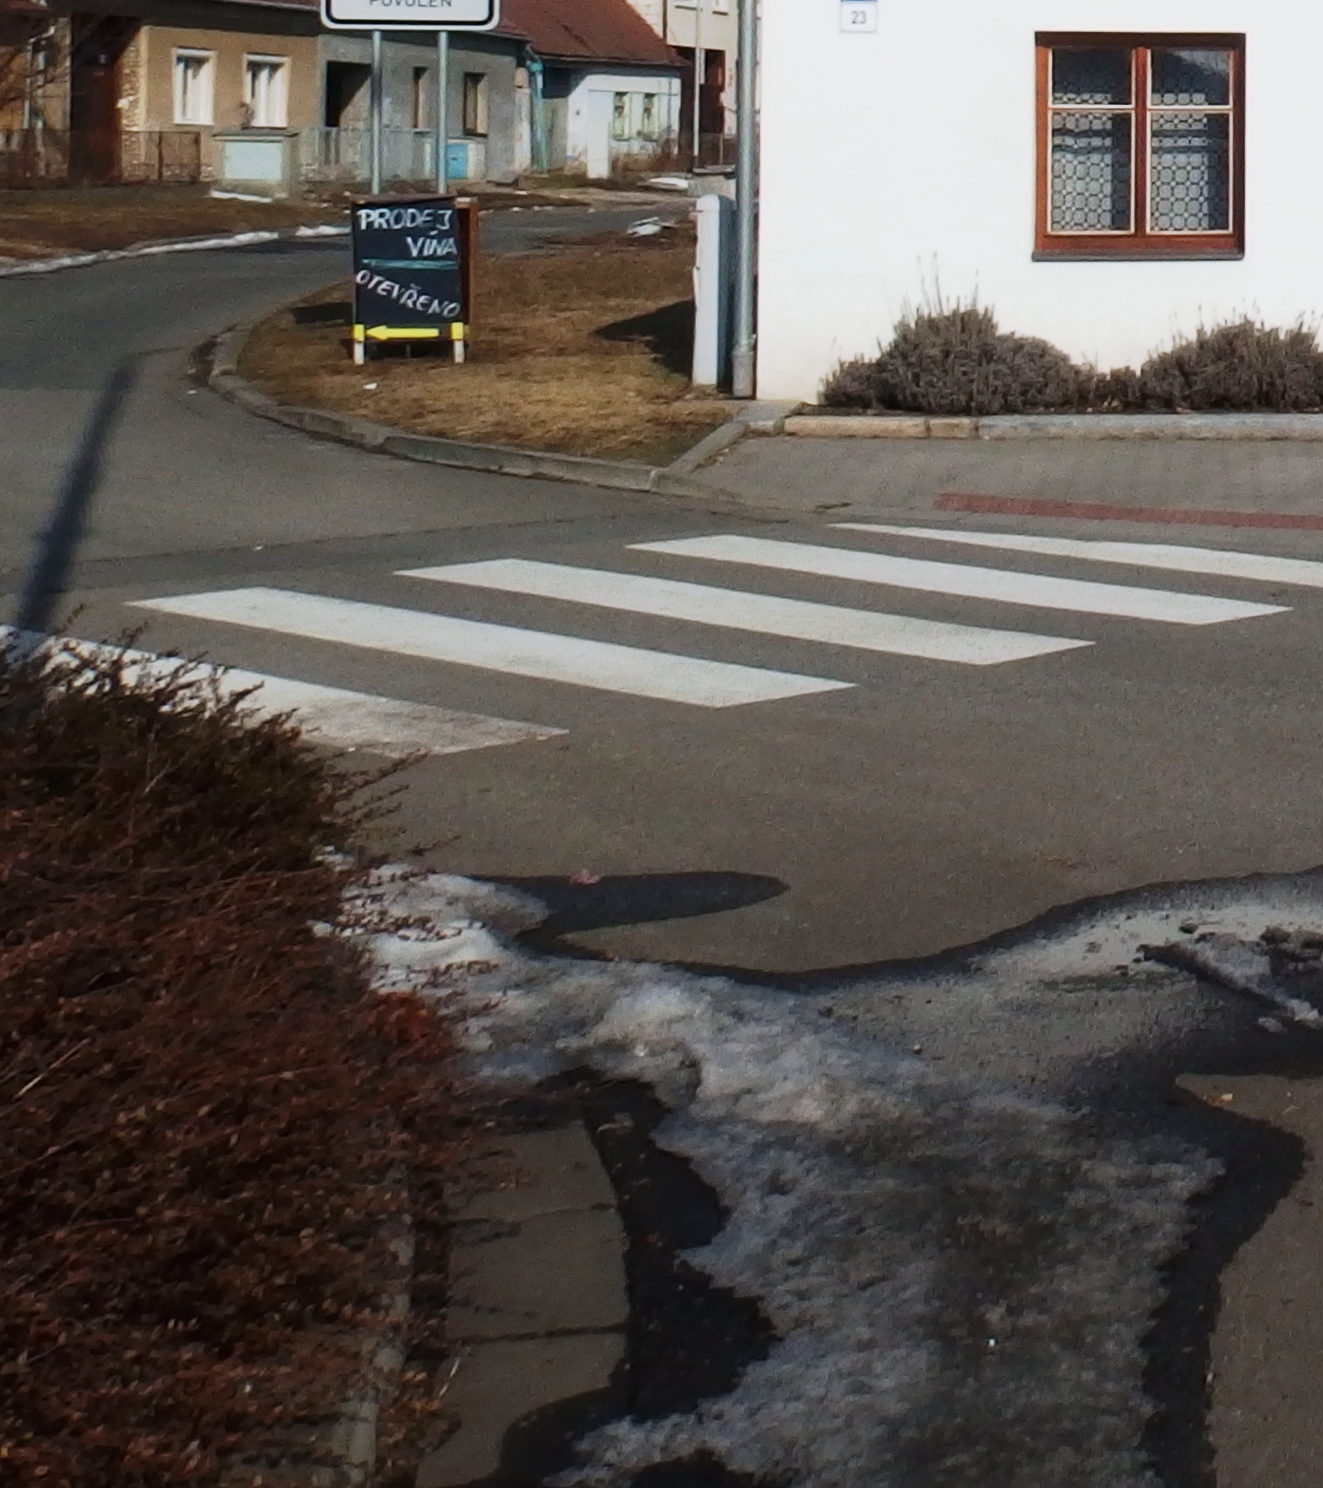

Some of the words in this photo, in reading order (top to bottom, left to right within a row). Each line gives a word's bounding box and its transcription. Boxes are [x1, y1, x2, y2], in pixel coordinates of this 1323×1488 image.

[851, 10, 867, 25] 23
[356, 208, 453, 230] PRODEJ
[406, 230, 458, 257] VÍNA
[355, 269, 461, 318] OTEVŘENO
